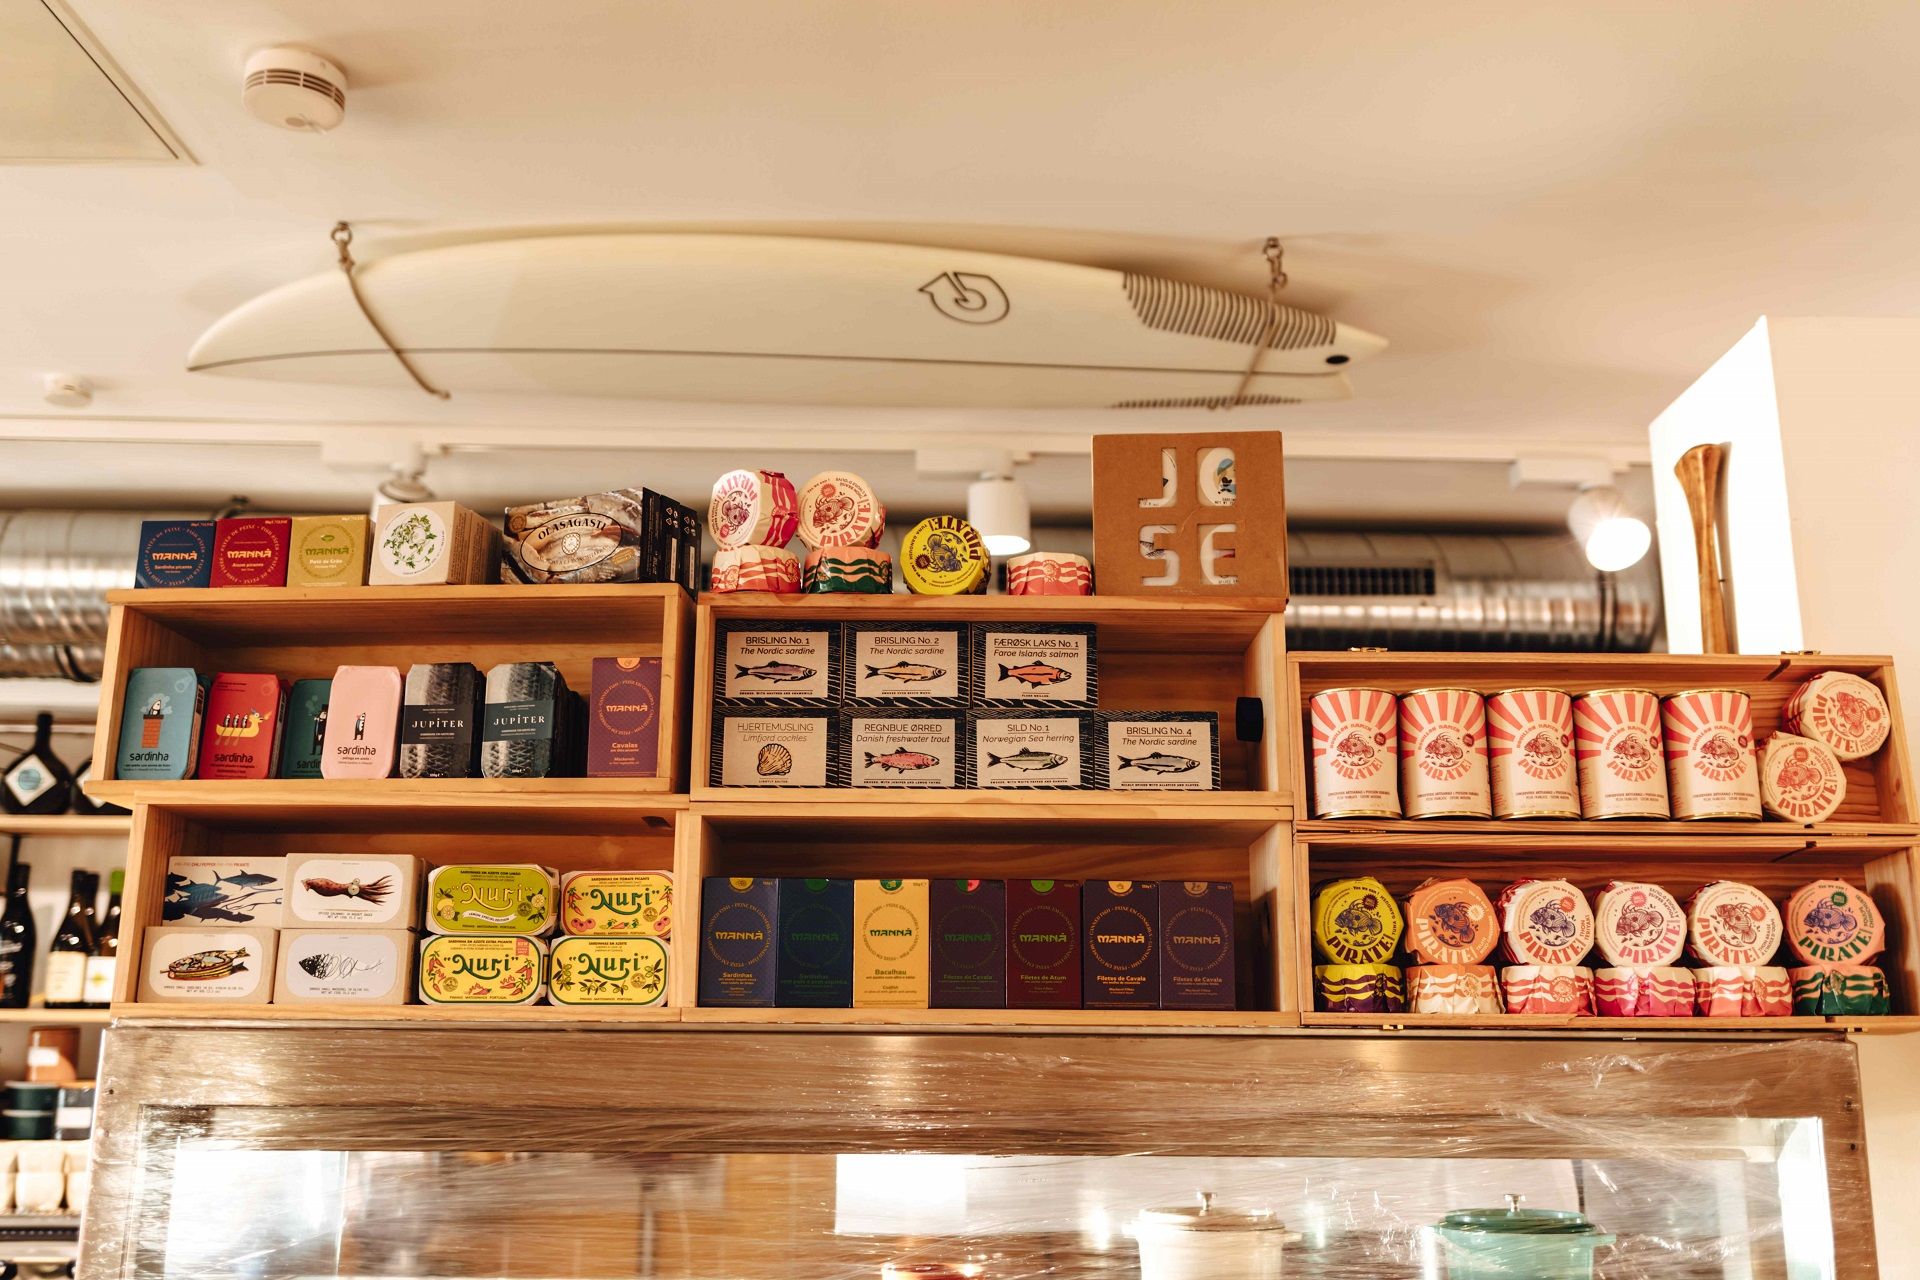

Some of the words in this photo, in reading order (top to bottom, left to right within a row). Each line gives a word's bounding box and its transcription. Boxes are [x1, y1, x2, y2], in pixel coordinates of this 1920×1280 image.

[538, 518, 606, 540] OLASAGASTI
[745, 636, 788, 645] BRISLING
[789, 637, 804, 645] No.
[874, 636, 916, 645] BRISLING
[917, 637, 932, 645] No.
[934, 637, 940, 645] 2
[993, 638, 1032, 647] FÆRØSK
[1033, 639, 1056, 647] LAKS
[1058, 640, 1073, 648] No.
[740, 647, 755, 655] The
[756, 647, 784, 655] Nordic
[785, 647, 815, 655] sardine
[869, 647, 884, 655] The
[886, 647, 913, 655] Nordic
[914, 647, 944, 655] sardine
[993, 649, 1017, 657] Faroe
[1018, 649, 1047, 658] Islands
[1049, 650, 1079, 658] salmon
[737, 723, 814, 732] HJERTEMUSLING
[864, 723, 908, 732] REGNBUE
[910, 724, 942, 732] ØRRED
[1007, 723, 1028, 732] SILD
[1045, 724, 1050, 732] 1
[1126, 726, 1168, 735] BRISLING
[1170, 727, 1184, 735] No.
[1186, 728, 1192, 736] 4
[743, 734, 776, 743] Limfjord
[856, 734, 884, 743] Danish
[885, 735, 929, 744] freshwater
[930, 735, 950, 743] trout
[983, 735, 1027, 744] Norwegian
[1028, 734, 1044, 742] Sea
[1045, 734, 1075, 743] herring
[1122, 737, 1137, 746] The
[1138, 738, 1165, 746] Nordic
[1167, 738, 1197, 746] sardine
[337, 745, 376, 756] sardinha
[129, 751, 169, 761] sardinha
[214, 752, 253, 763] sardinha
